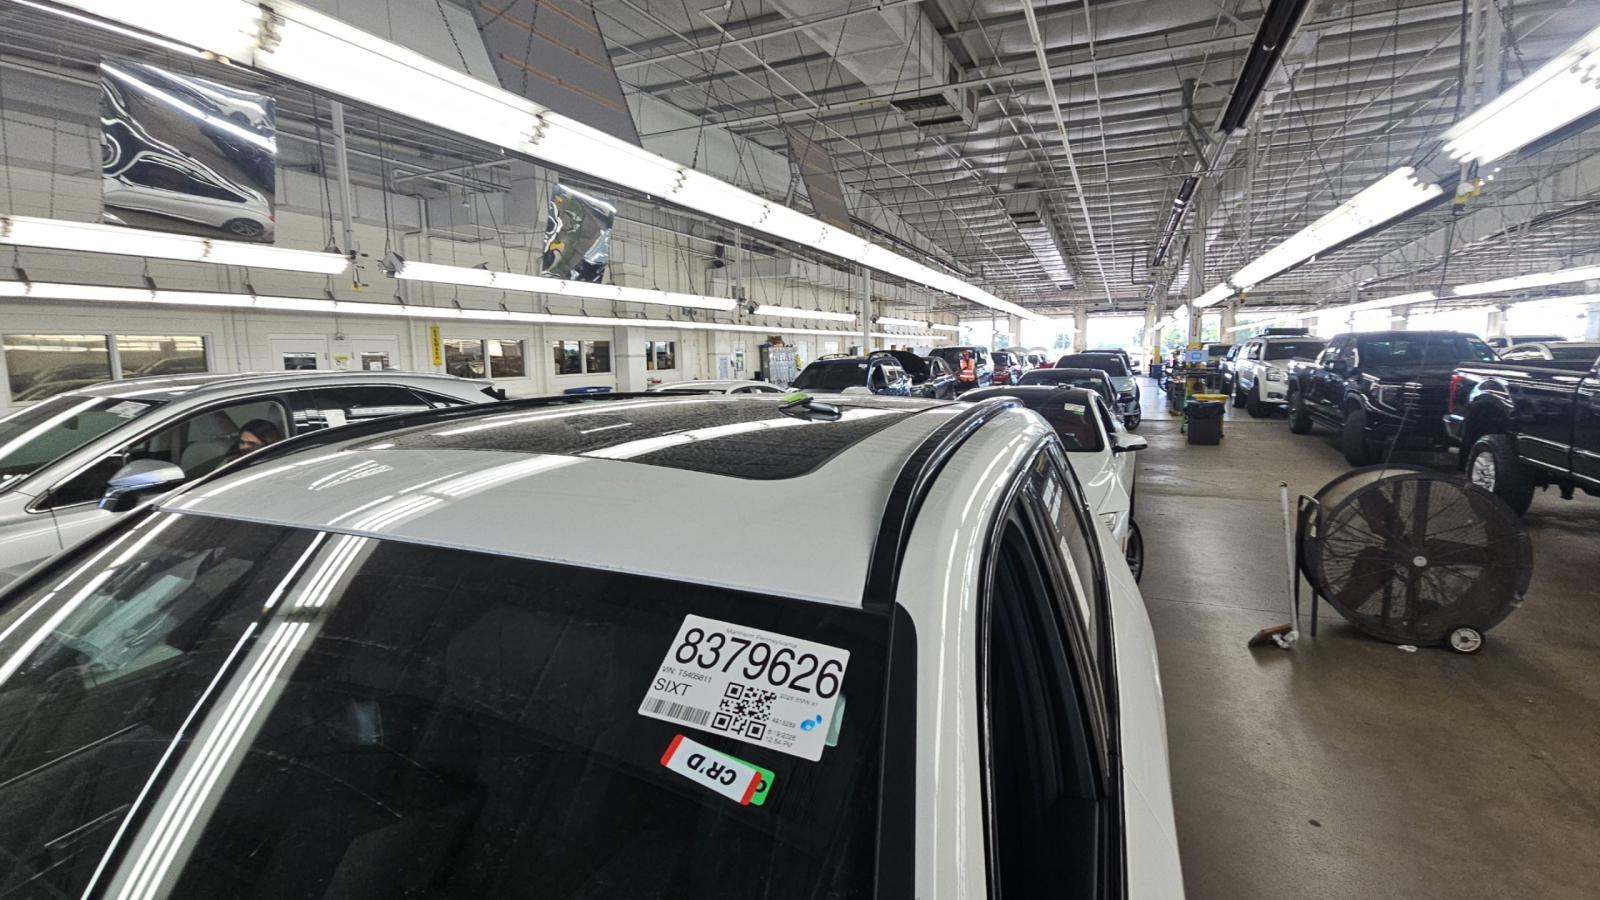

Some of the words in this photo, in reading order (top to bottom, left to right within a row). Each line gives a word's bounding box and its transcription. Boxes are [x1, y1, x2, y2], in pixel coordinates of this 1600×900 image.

[675, 627, 843, 699] 8379626
[654, 677, 693, 697] SIXT
[686, 753, 737, 786] CR'D
